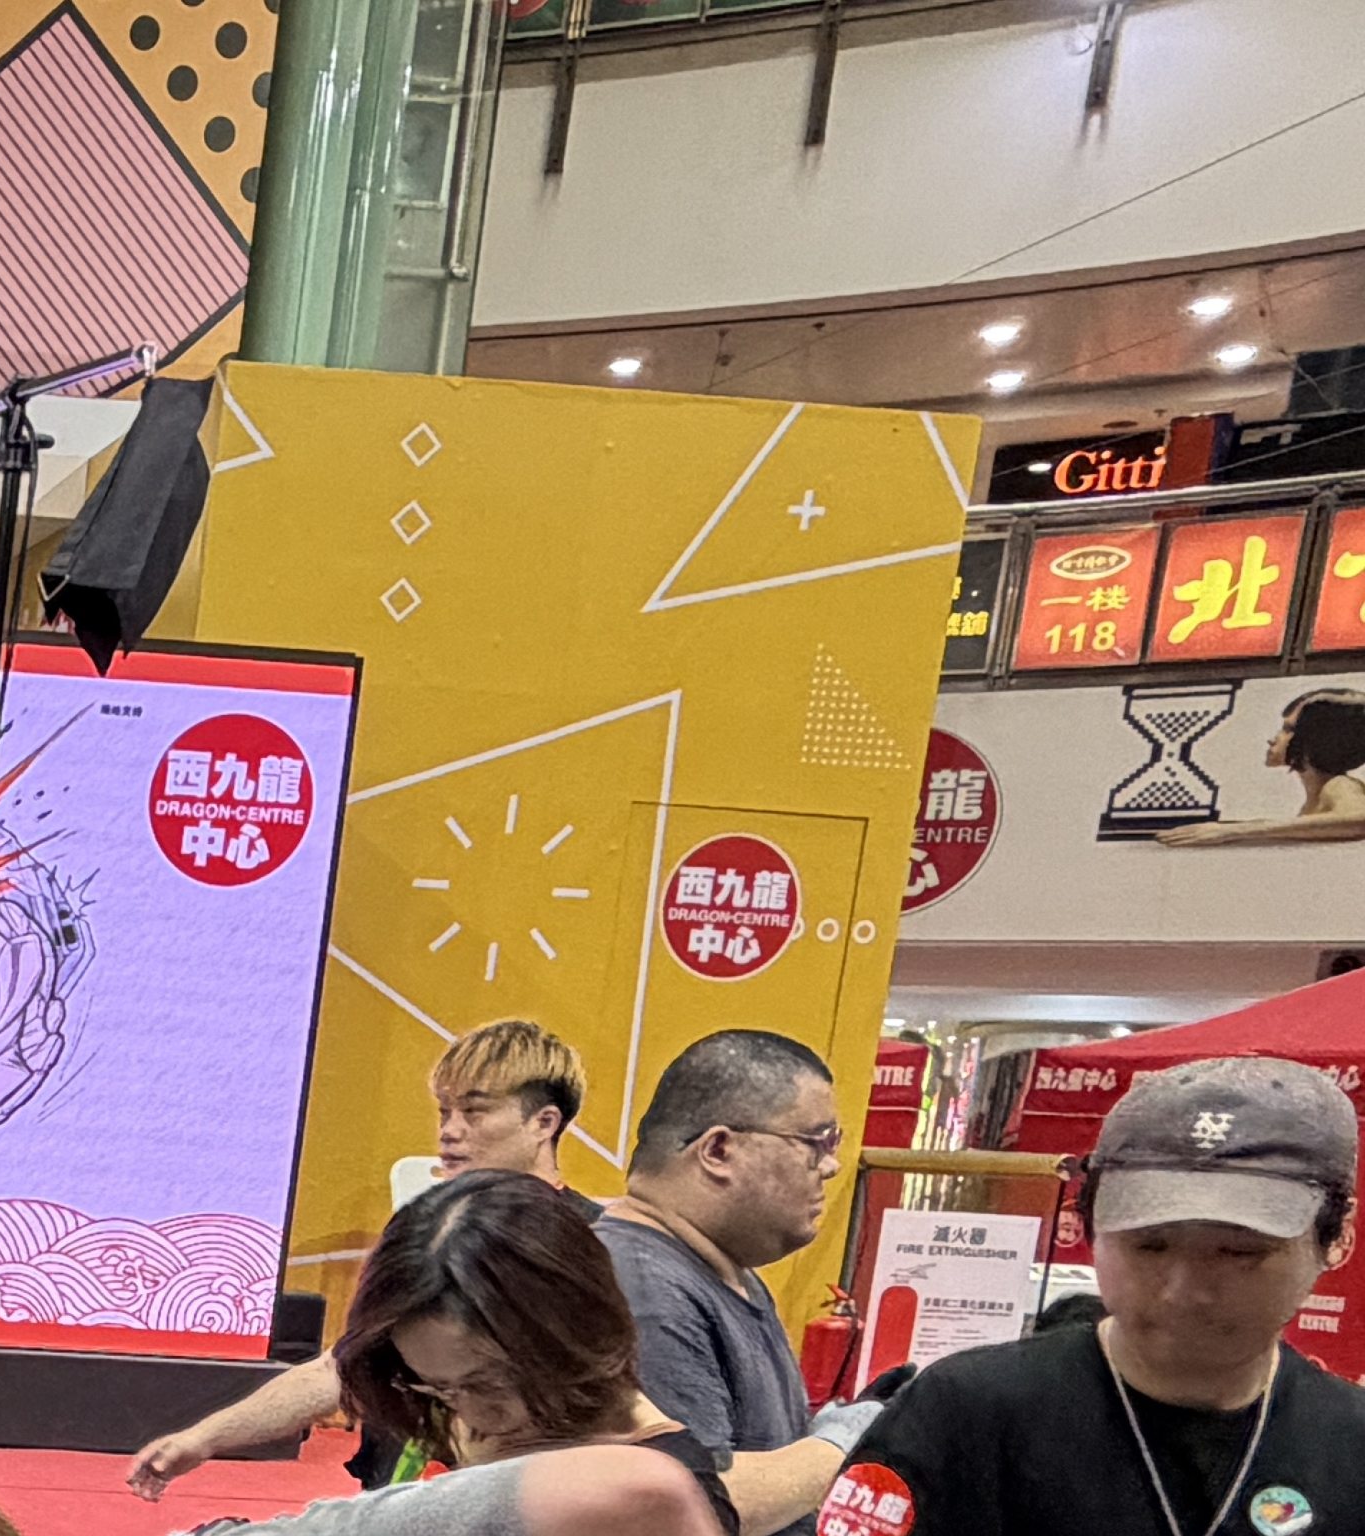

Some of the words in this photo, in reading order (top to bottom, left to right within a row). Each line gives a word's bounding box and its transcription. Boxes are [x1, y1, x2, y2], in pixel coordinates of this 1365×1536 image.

[1045, 622, 1117, 655] 118
[164, 749, 304, 805] 西九龍
[181, 820, 271, 870] 中心
[675, 866, 791, 910] 西九龍
[687, 923, 762, 965] 中心
[896, 1243, 924, 1255] FIRE
